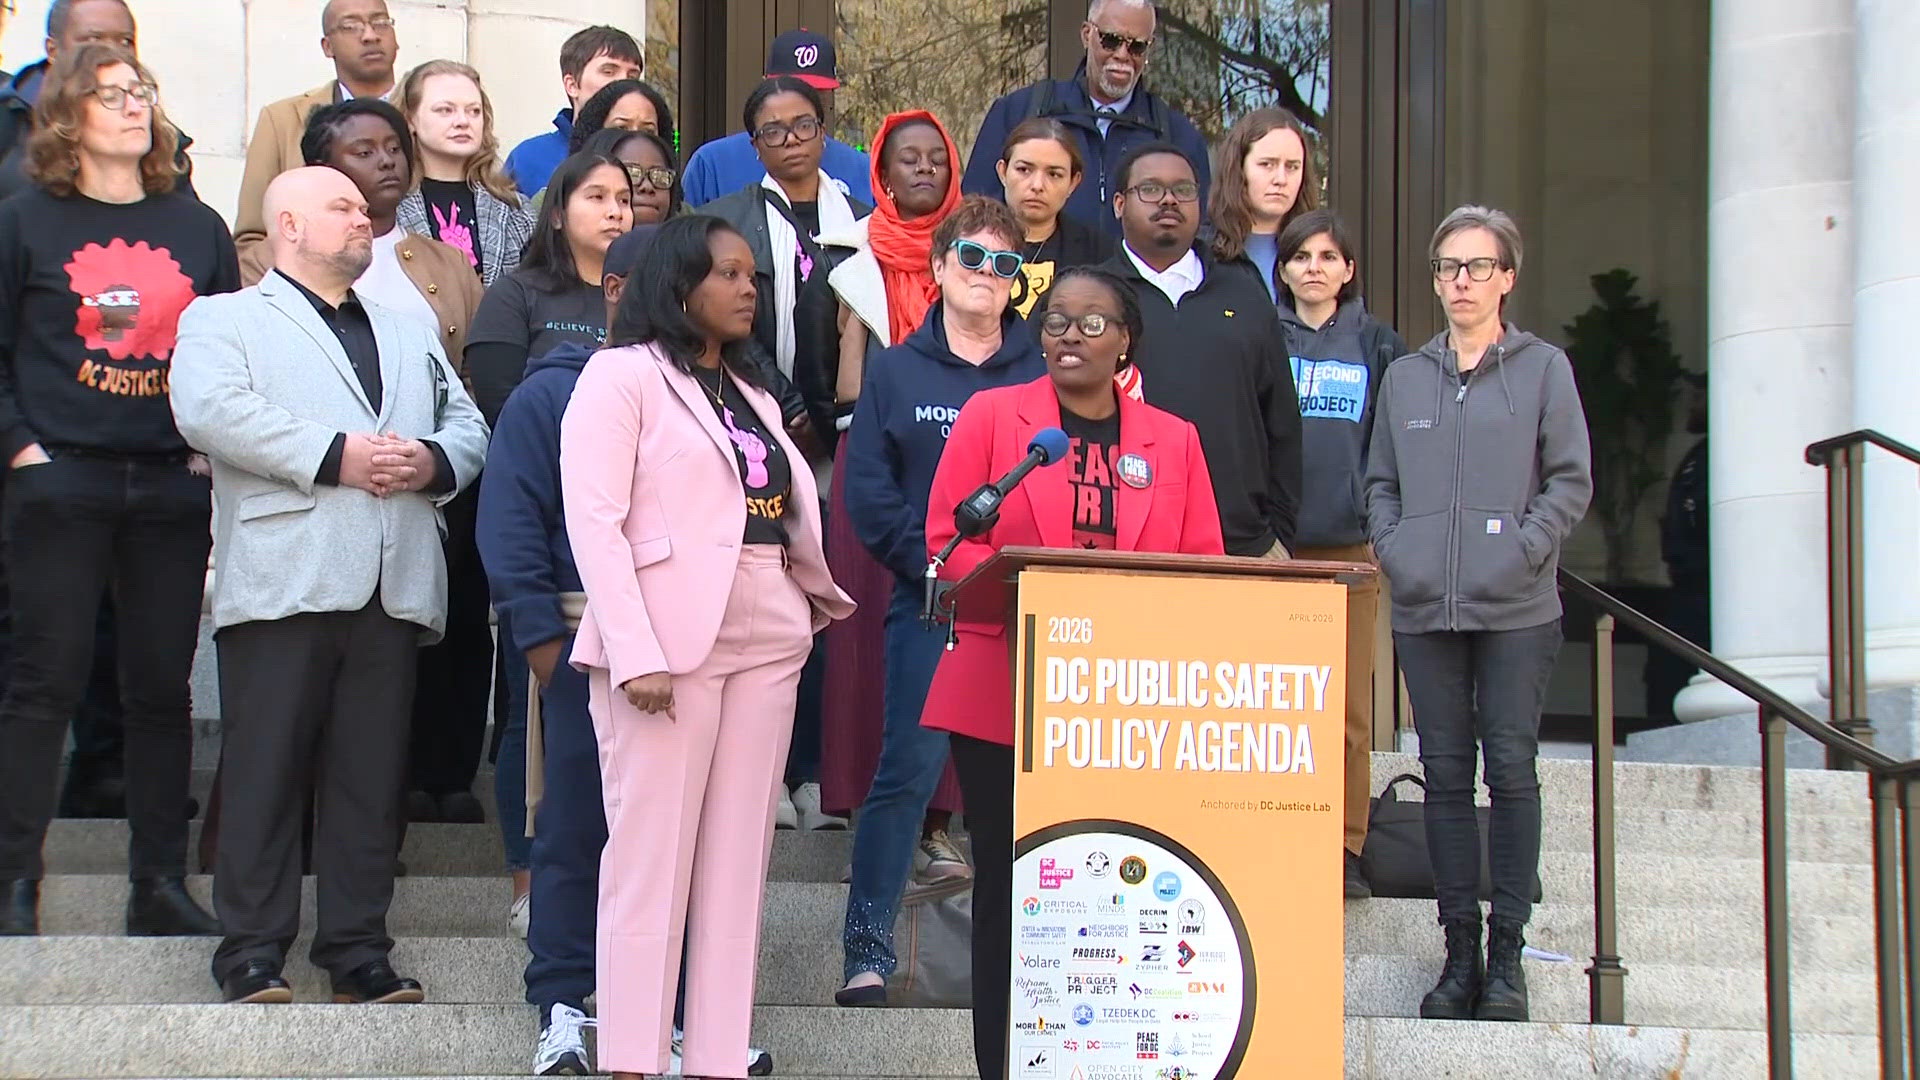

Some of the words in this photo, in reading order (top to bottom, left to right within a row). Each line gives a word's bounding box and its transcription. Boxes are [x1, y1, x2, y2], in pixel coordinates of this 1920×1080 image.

[794, 44, 818, 68] W
[546, 321, 593, 334] BELIEVE
[77, 359, 102, 388] DC
[99, 366, 161, 397] JUSTICE
[1304, 365, 1361, 383] SECOND
[1300, 395, 1357, 414] ROJECT
[915, 405, 960, 423] MOR
[1289, 613, 1310, 622] APRIL
[1313, 614, 1334, 623] 2026
[1048, 616, 1093, 644] 2026
[1046, 656, 1090, 705] DC
[1096, 658, 1210, 708] PUBLIC
[1214, 661, 1332, 712] SAFETY
[1044, 715, 1170, 770] POLICY
[1174, 719, 1315, 774] AGENDA
[1200, 799, 1245, 810] Anchored
[1248, 800, 1259, 812] by
[1260, 801, 1274, 810] DC
[1276, 801, 1311, 811] Justice
[1313, 802, 1331, 811] Lab
[1042, 869, 1071, 877] JUSTICE
[1044, 900, 1087, 909] CRITICAL
[1097, 905, 1126, 913] MINDS
[1182, 926, 1201, 934] IBW
[1072, 948, 1116, 958] PROGRESS
[1020, 953, 1060, 968] Volare
[1015, 977, 1049, 991] Reframe
[1102, 1008, 1140, 1018] TZEDEK
[1142, 1008, 1156, 1018] DC
[1016, 1022, 1036, 1030] MORE
[1045, 1022, 1066, 1030] THAN
[1137, 1032, 1159, 1042] PEACE
[1137, 1043, 1149, 1051] FOR
[1150, 1043, 1159, 1051] DC
[1087, 1064, 1117, 1073] OPEN
[1120, 1065, 1144, 1073] CITY
